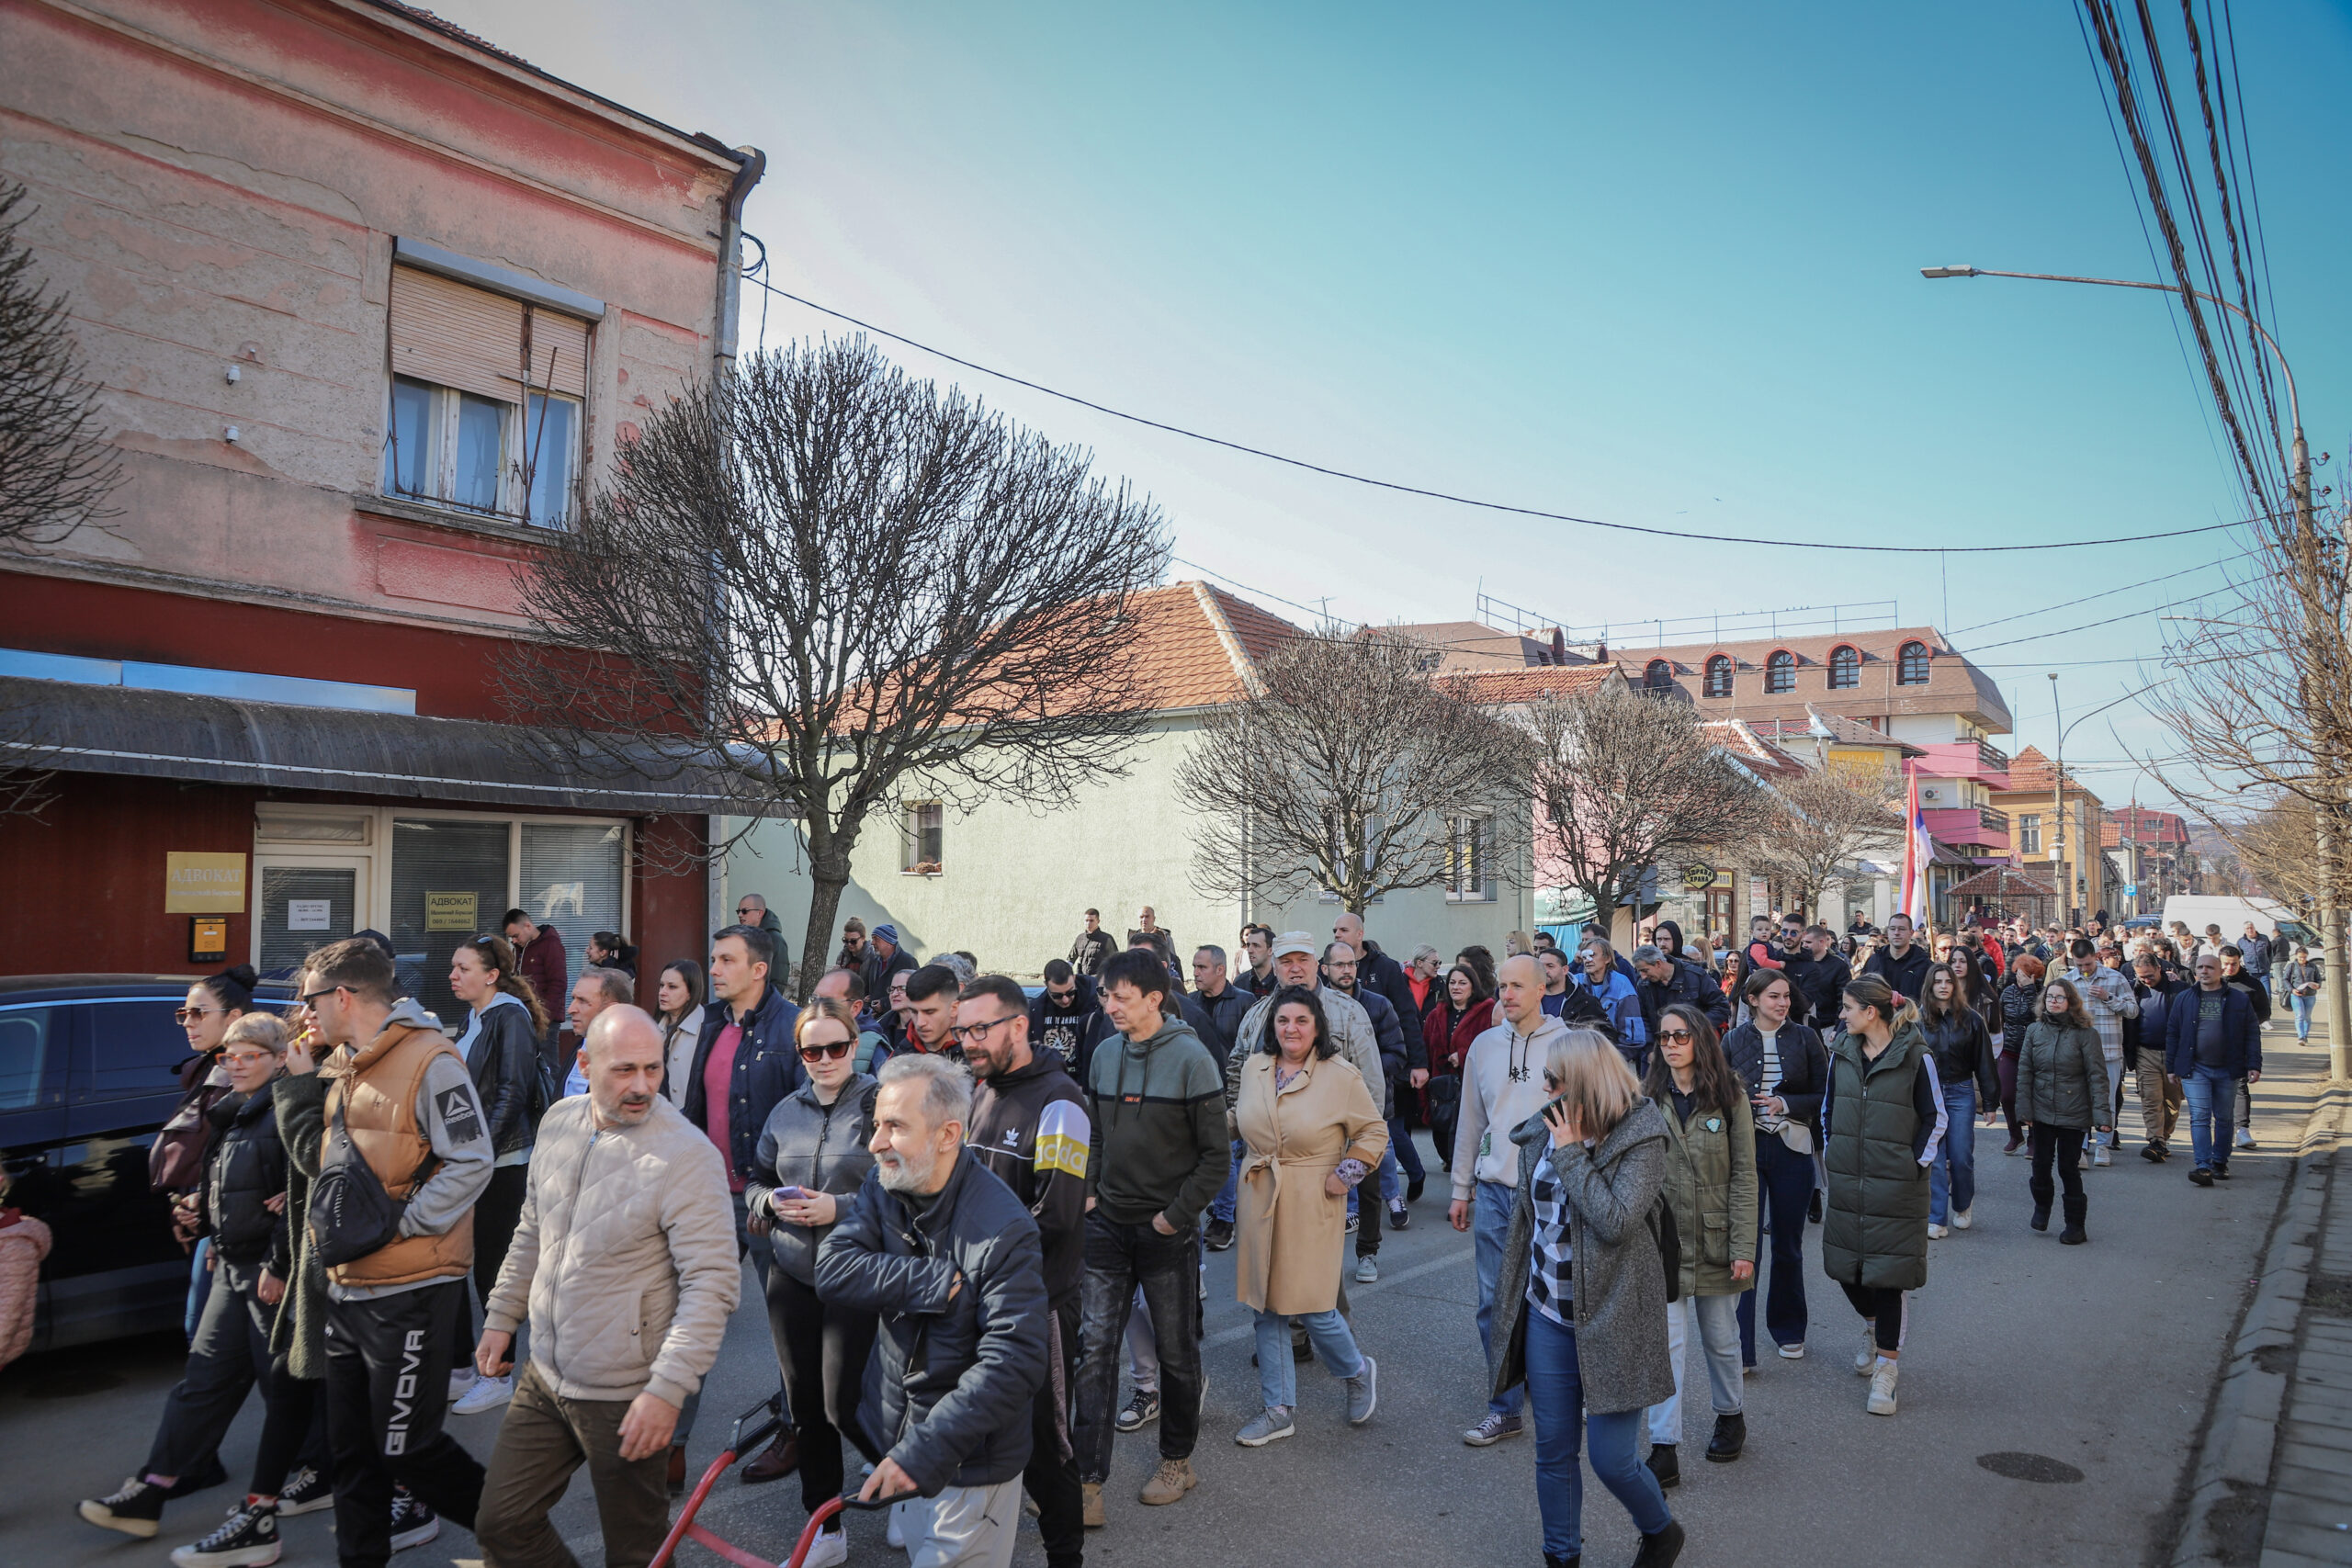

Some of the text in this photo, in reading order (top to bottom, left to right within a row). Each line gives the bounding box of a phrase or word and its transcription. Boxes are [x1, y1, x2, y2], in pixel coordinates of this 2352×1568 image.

[171, 868, 243, 884] АДВОКАТ
[431, 897, 473, 907] АДВОКАТ
[1510, 1066, 1531, 1083] 東京
[444, 1112, 477, 1125] Reebok
[384, 1330, 425, 1456] GIVOVA
